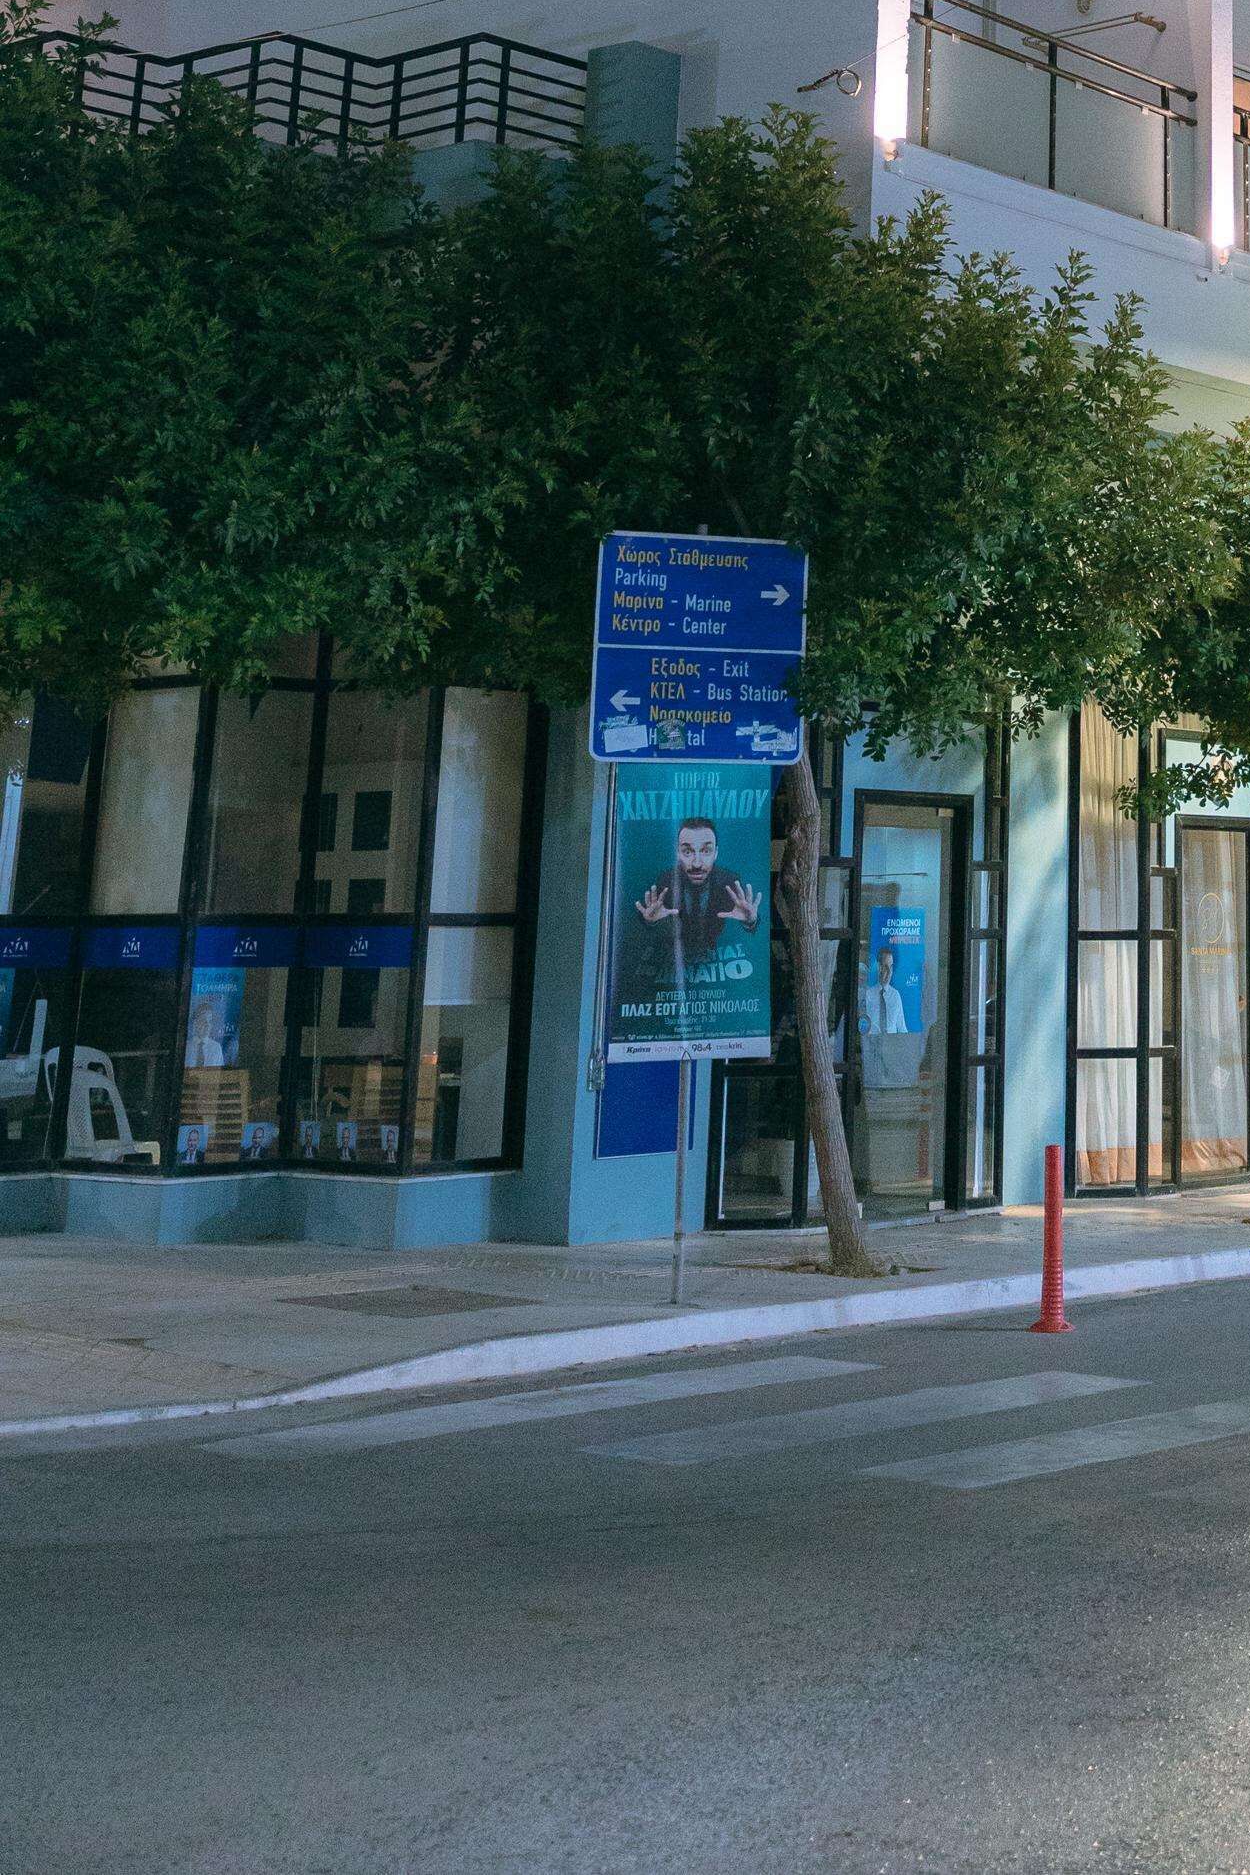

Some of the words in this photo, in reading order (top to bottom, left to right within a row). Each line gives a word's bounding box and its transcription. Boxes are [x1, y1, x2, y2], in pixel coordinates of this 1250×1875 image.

[617, 545, 661, 567] Χώρος
[669, 547, 749, 571] Στάθμευσης
[615, 568, 667, 591] Parking
[613, 590, 664, 613] Μαρίνα
[685, 594, 732, 613] Marine
[612, 614, 661, 636] Κέντρο
[682, 617, 727, 635] Center
[723, 660, 750, 678] Exit
[707, 683, 732, 701] Bus
[621, 1003, 651, 1017] ΠΛΑΖ
[679, 1001, 707, 1015] ΑΓΙΟΣ
[709, 999, 760, 1014] ΝΙΚΟΛΑΟΣ
